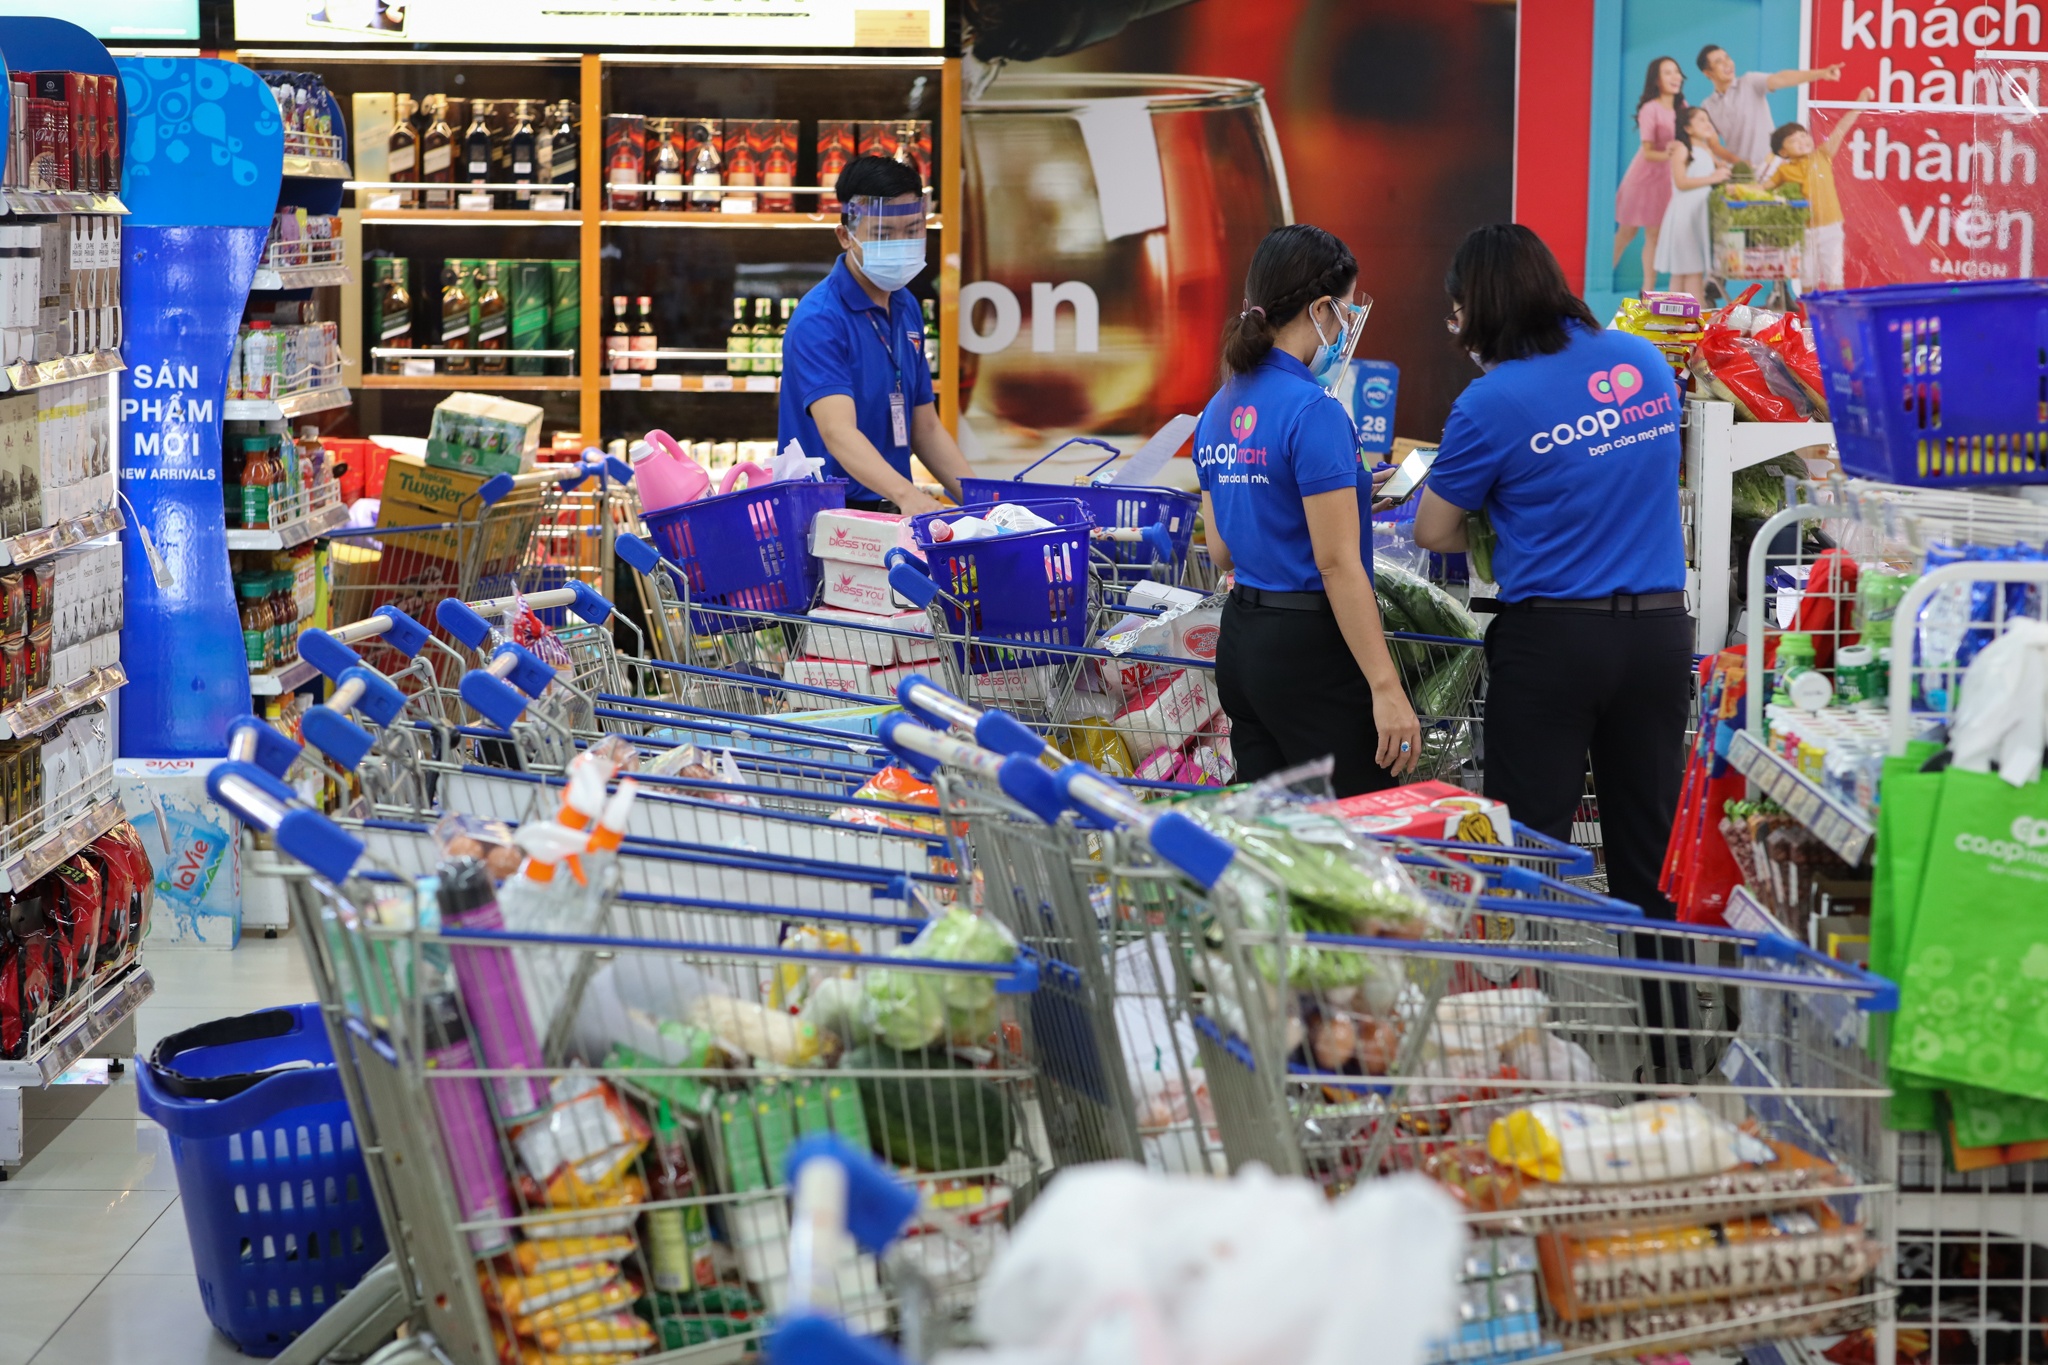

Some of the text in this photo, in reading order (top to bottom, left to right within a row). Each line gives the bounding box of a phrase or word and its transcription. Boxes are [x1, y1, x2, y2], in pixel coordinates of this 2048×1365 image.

[1841, 0, 2041, 50] khách
[1878, 56, 2041, 125] hàng
[1848, 127, 2037, 186] thành
[1899, 193, 2034, 272] viên
[959, 280, 1100, 355] on
[133, 358, 198, 389] SẢN
[120, 390, 213, 423] PHẨM
[134, 424, 200, 456] MỚI
[1360, 415, 1387, 432] 28
[1588, 442, 1613, 457] bạn
[1614, 436, 1637, 449] của
[118, 467, 216, 481] NEW ARRIVALS
[400, 472, 466, 504] Twister
[1669, 1263, 1733, 1294] KIM
[1742, 1252, 1806, 1285] TÂY
